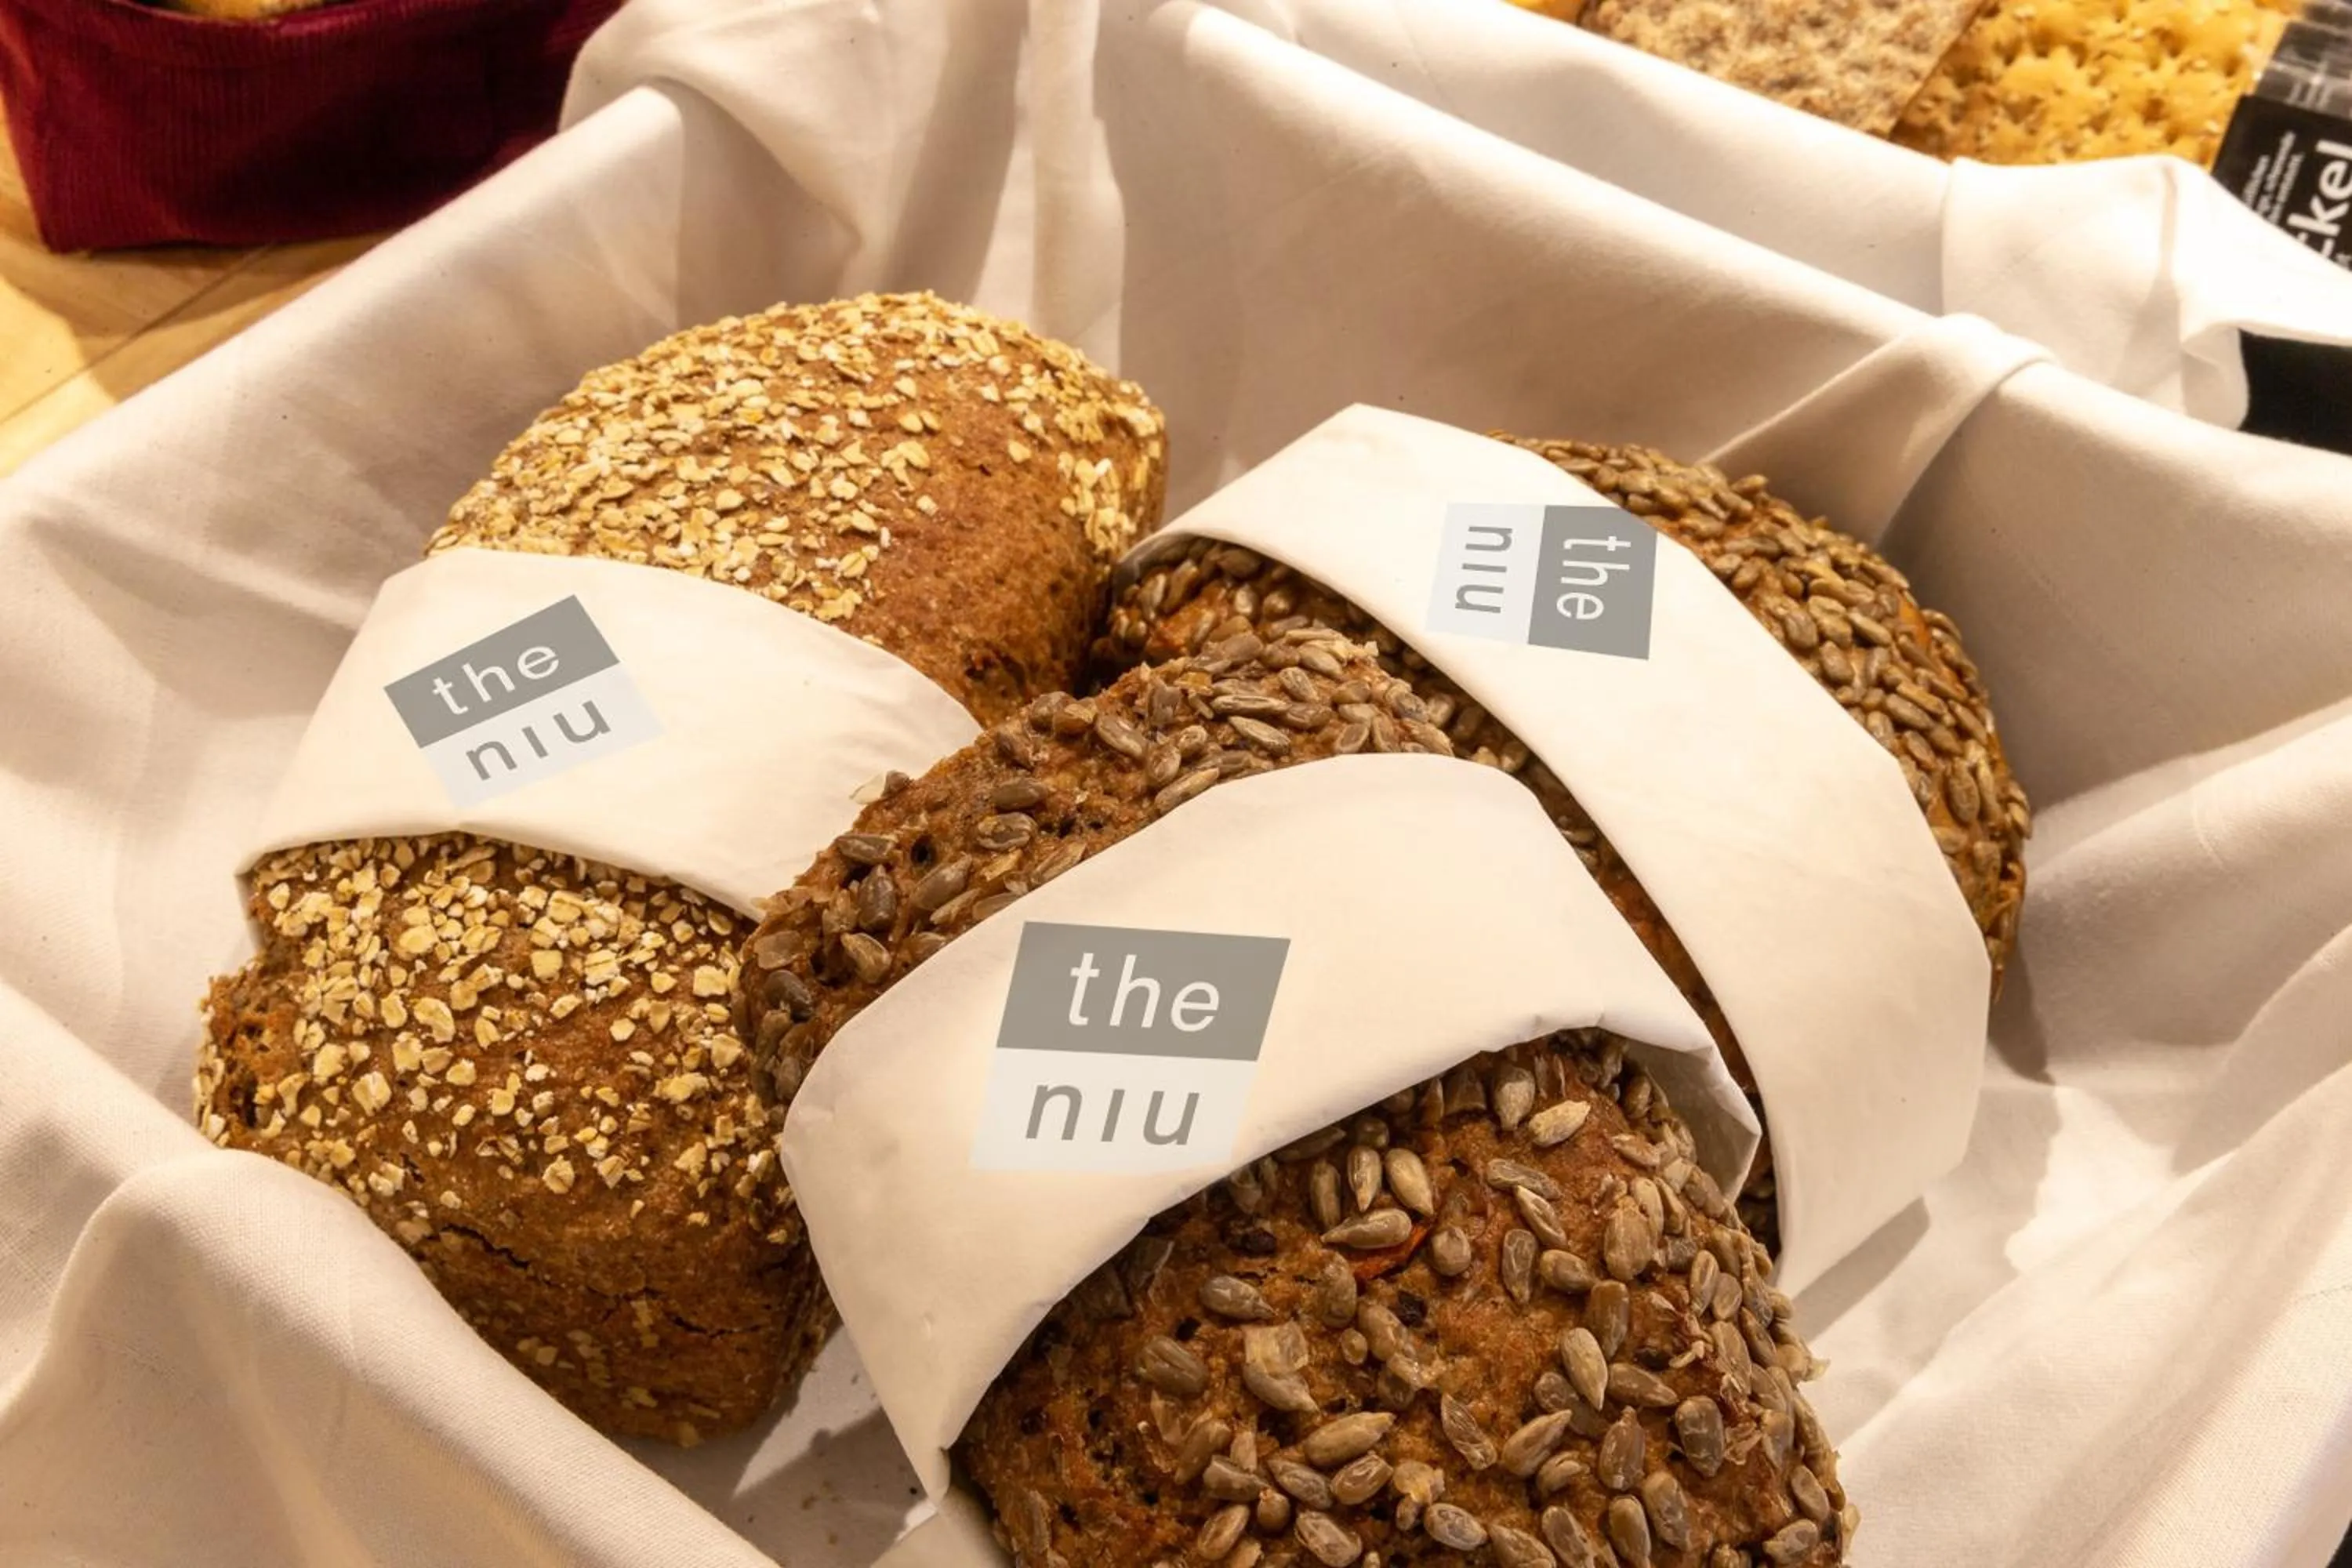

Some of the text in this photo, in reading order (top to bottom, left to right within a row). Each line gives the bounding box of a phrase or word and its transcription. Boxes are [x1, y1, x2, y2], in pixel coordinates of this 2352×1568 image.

[1556, 535, 1632, 620] the
[432, 645, 560, 716] the
[1068, 952, 1221, 1032] the
[1025, 1084, 1200, 1145] niu
